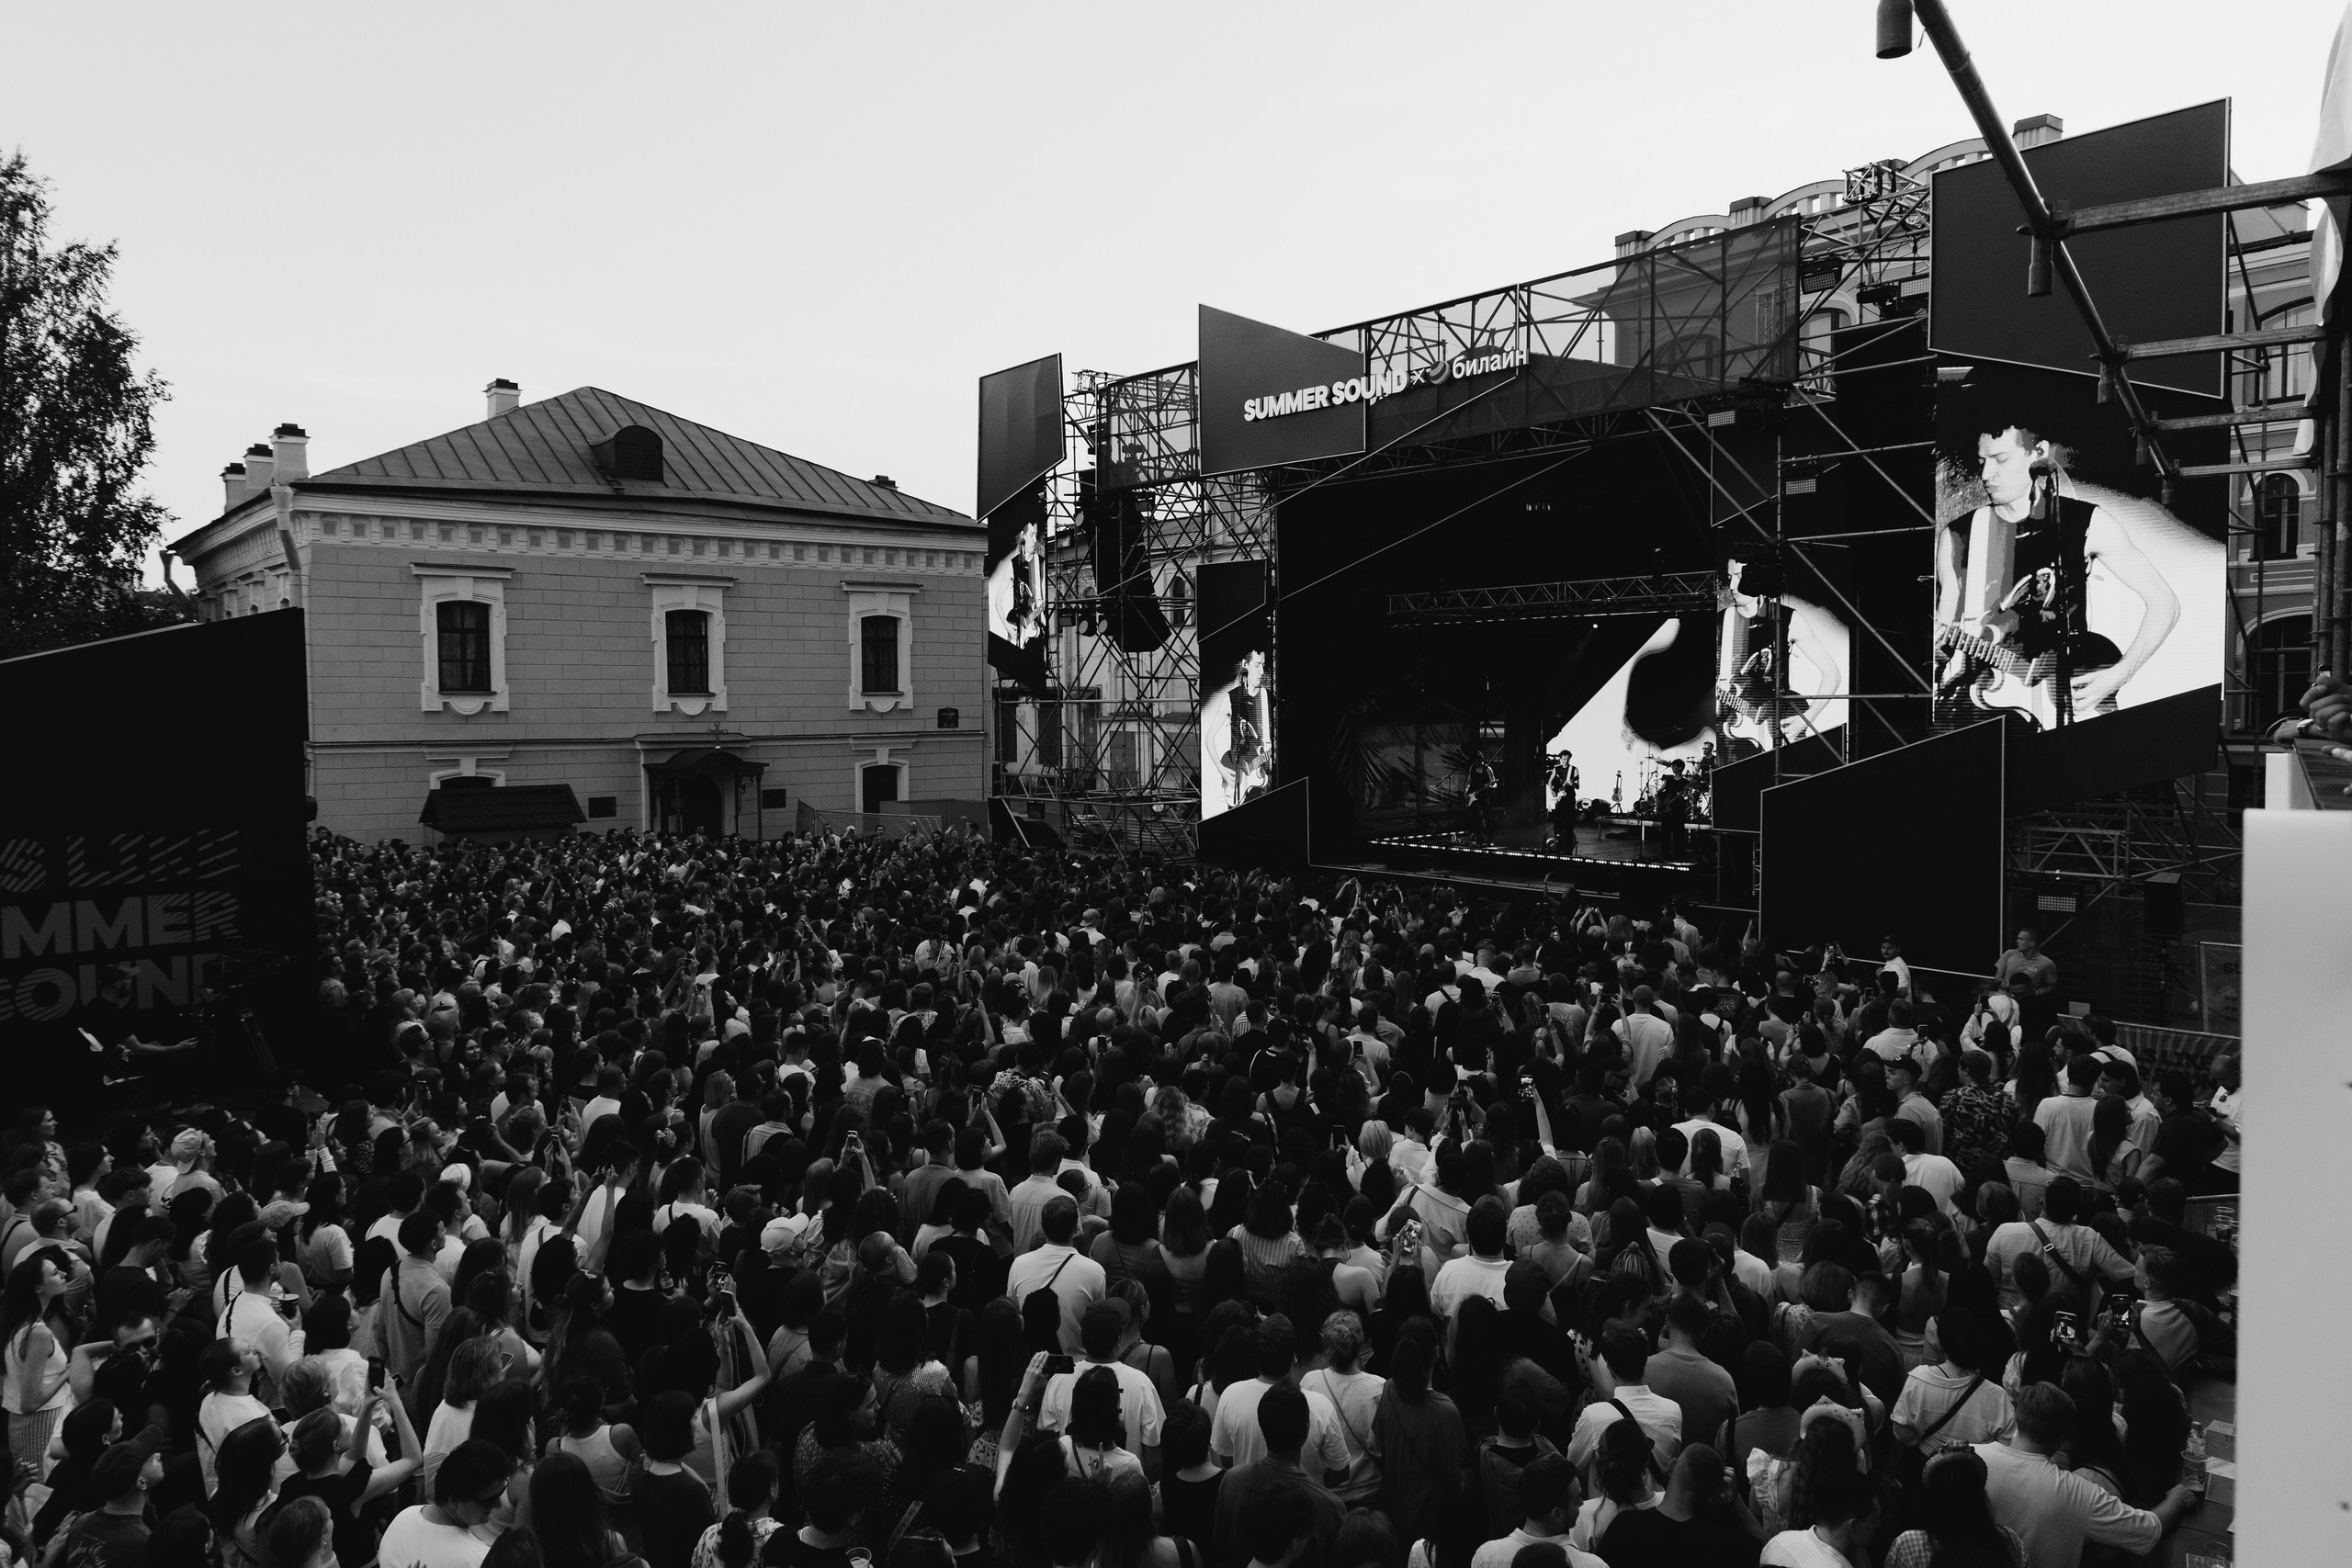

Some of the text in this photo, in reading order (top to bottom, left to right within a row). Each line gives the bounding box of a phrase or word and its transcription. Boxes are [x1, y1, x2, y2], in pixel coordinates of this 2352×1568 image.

[1453, 345, 1529, 379] билайн
[1243, 385, 1330, 423] SUMMER
[1331, 368, 1410, 406] SOUND
